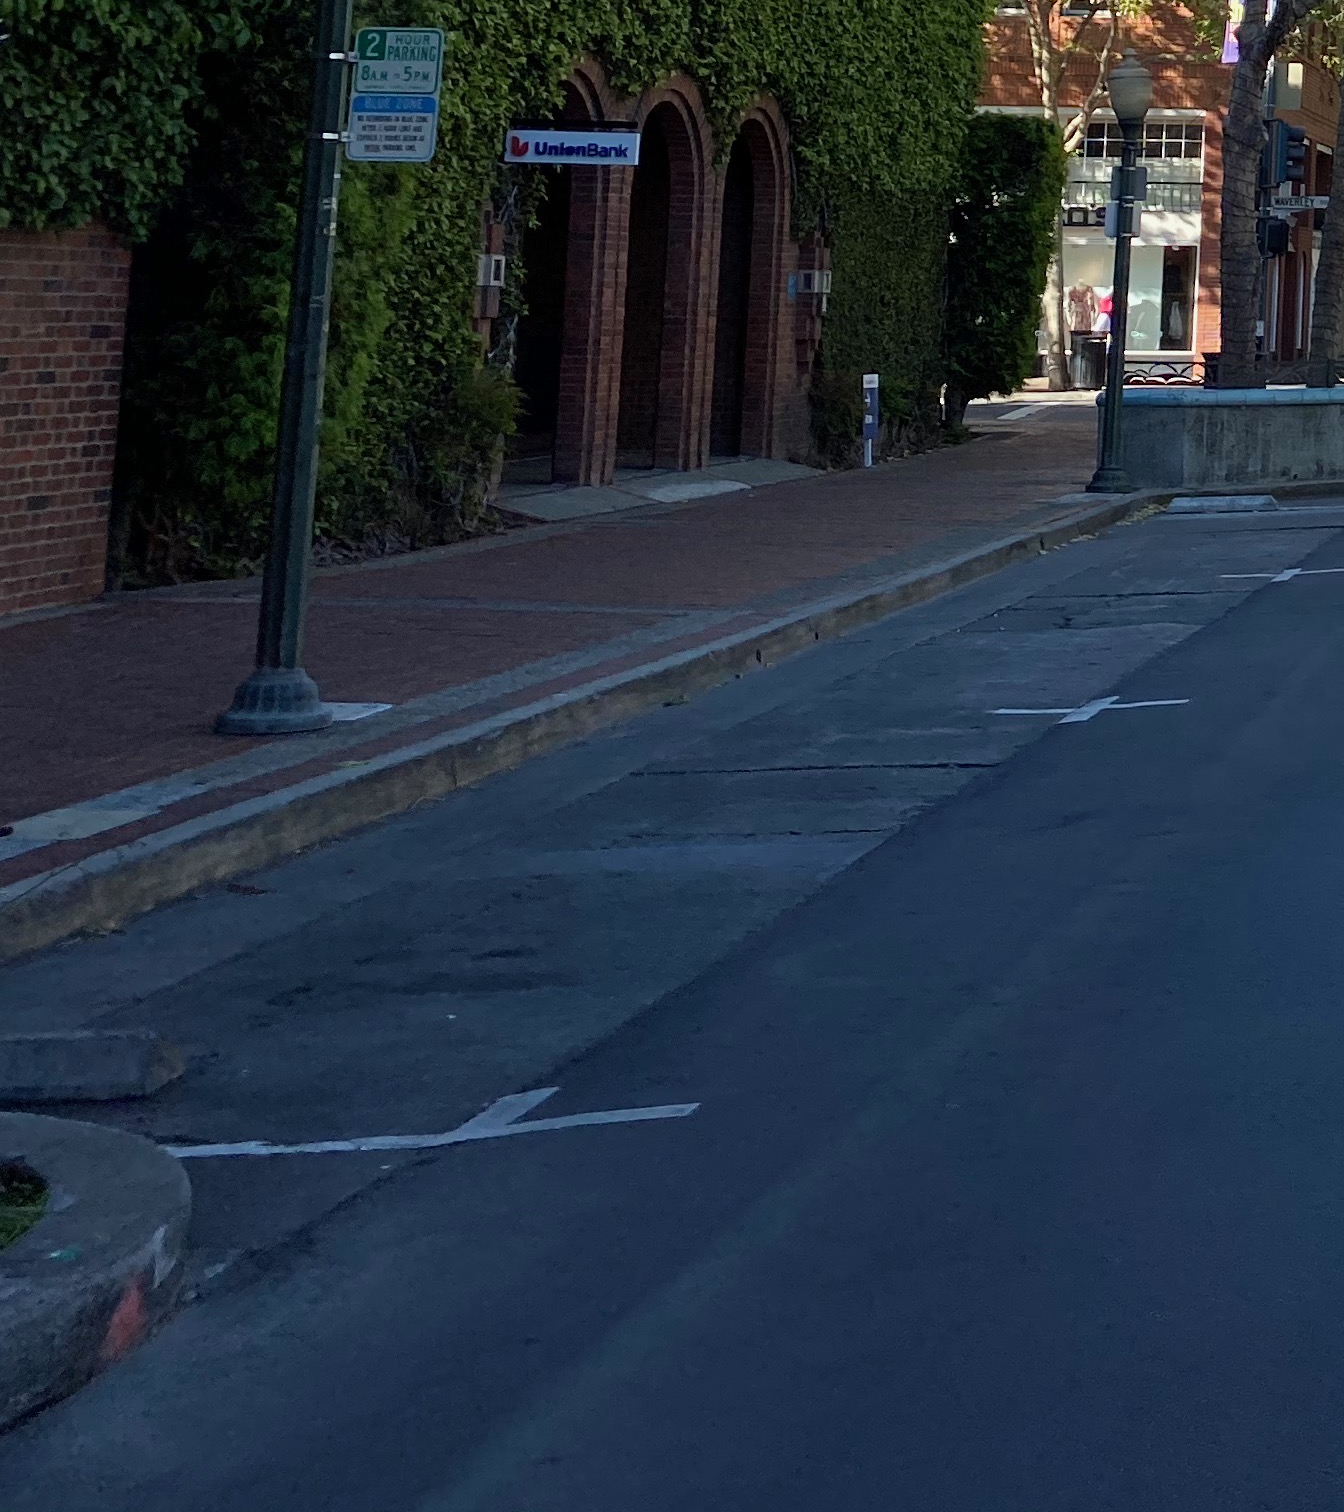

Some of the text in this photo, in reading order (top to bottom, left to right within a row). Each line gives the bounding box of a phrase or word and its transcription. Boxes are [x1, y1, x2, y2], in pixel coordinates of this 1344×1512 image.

[366, 33, 430, 57] 2 HOUR
[387, 46, 437, 62] PARKING
[534, 141, 629, 158] UnionBank
[1274, 197, 1315, 207] WAVERLEY
